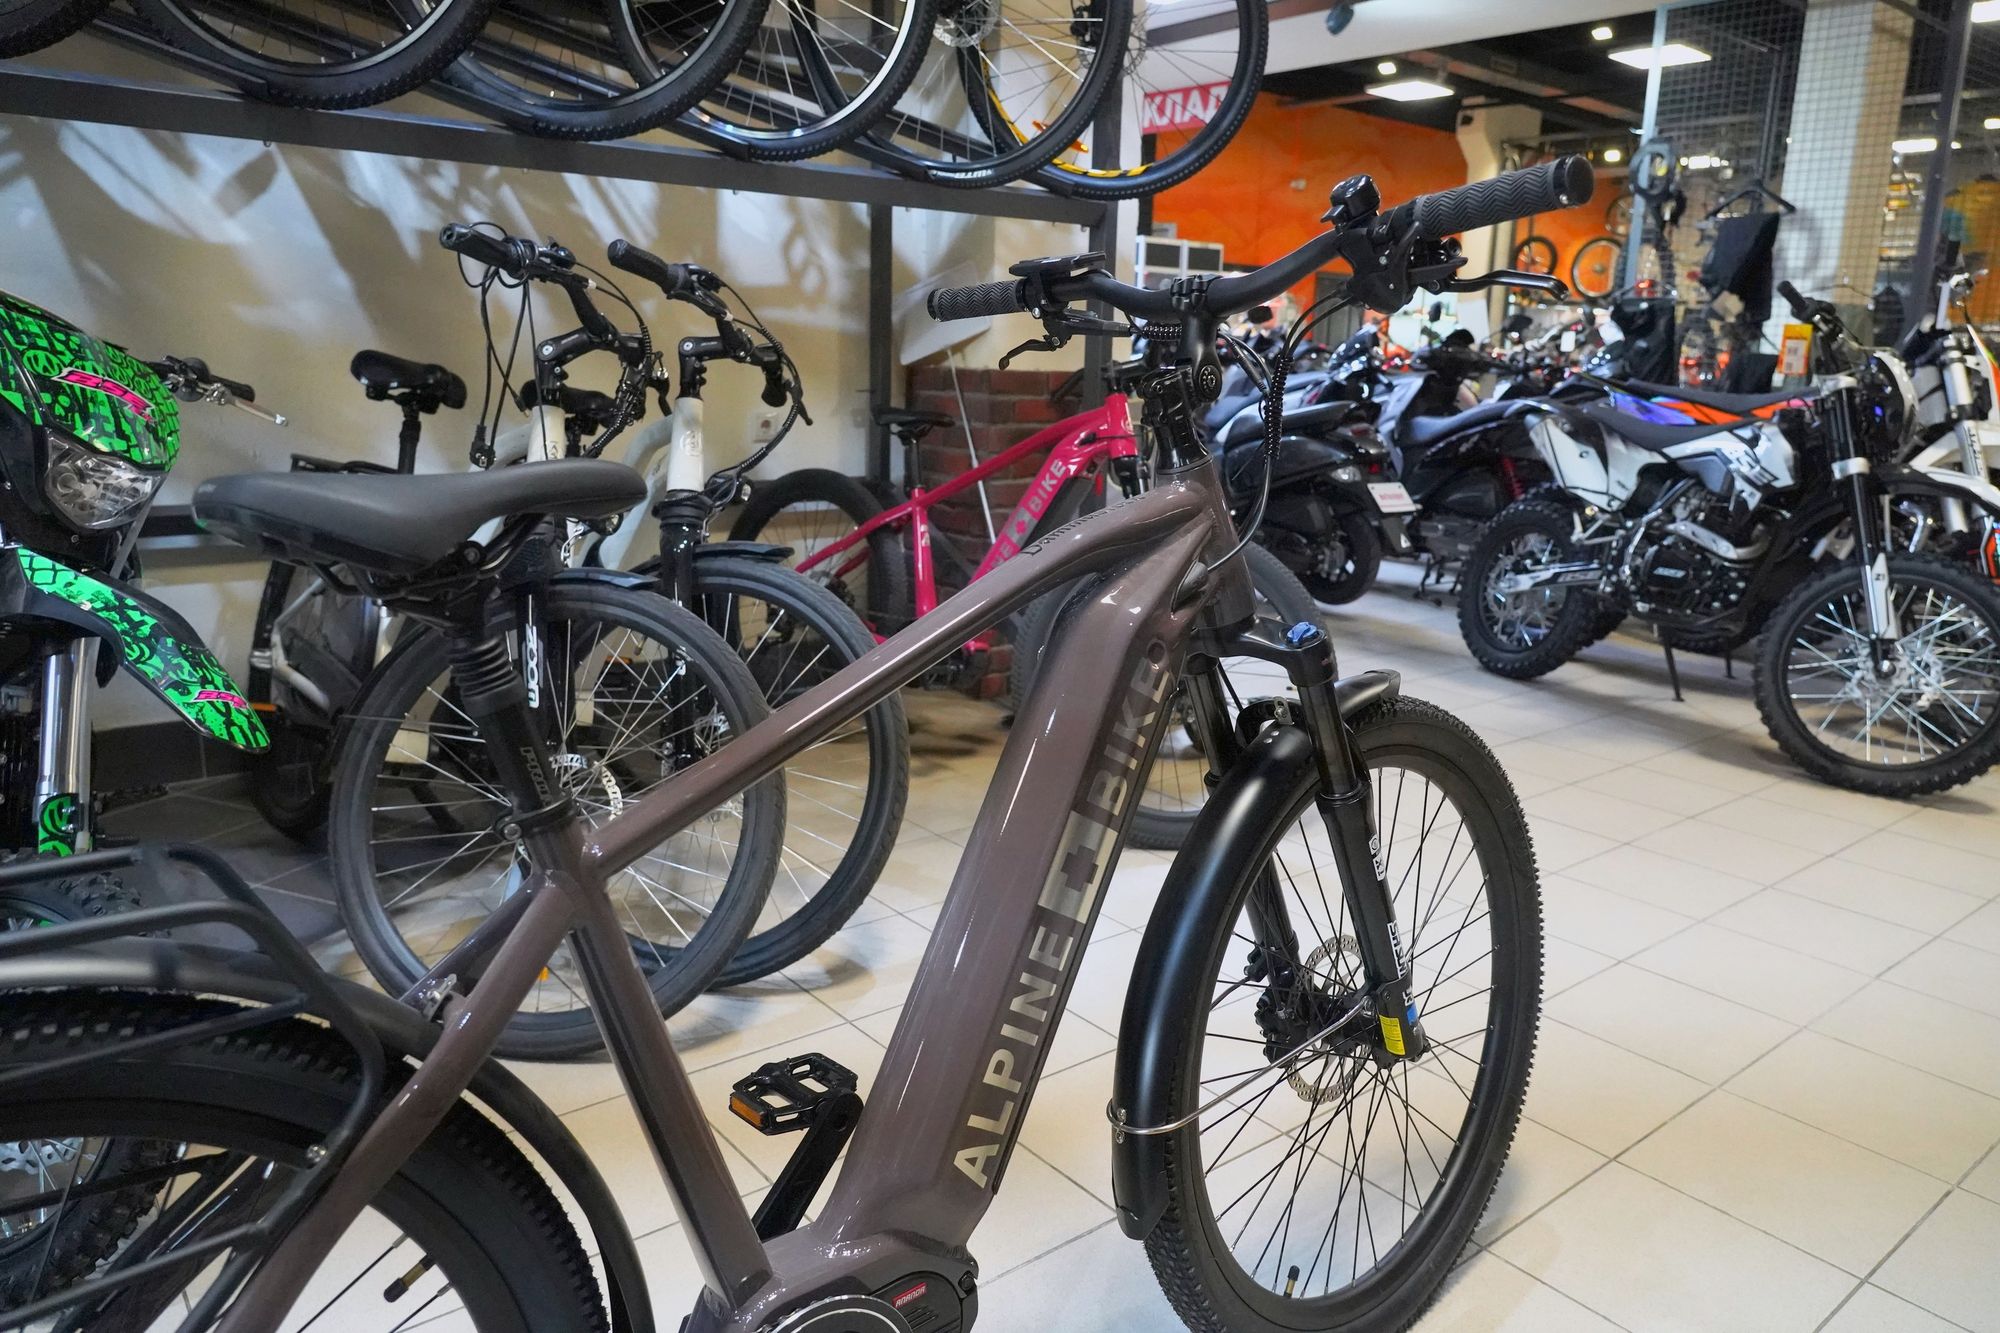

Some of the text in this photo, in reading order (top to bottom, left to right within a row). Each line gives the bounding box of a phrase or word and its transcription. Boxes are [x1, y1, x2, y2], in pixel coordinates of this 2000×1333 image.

[1028, 458, 1066, 513] BIKE
[953, 657, 1171, 1189] ALPINE BIKE
